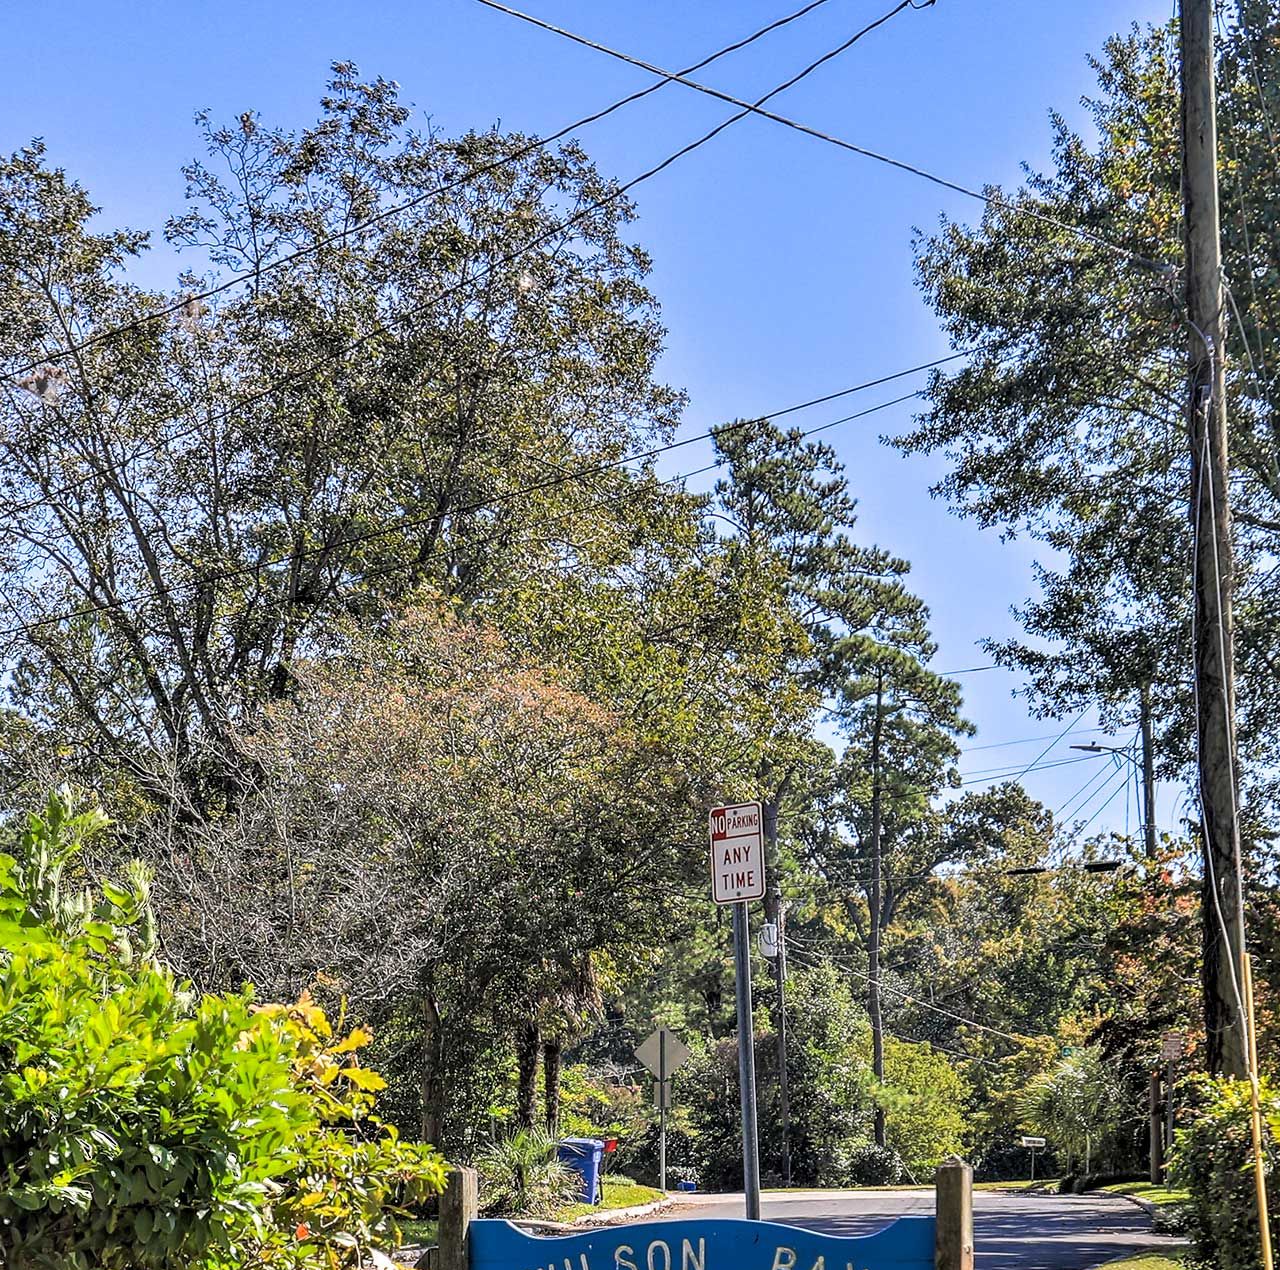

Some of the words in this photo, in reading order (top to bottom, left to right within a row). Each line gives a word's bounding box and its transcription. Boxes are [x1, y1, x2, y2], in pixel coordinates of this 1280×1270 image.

[712, 815, 725, 834] NO
[727, 814, 758, 830] PARKING
[723, 846, 751, 865] ANY
[722, 871, 755, 890] TIME
